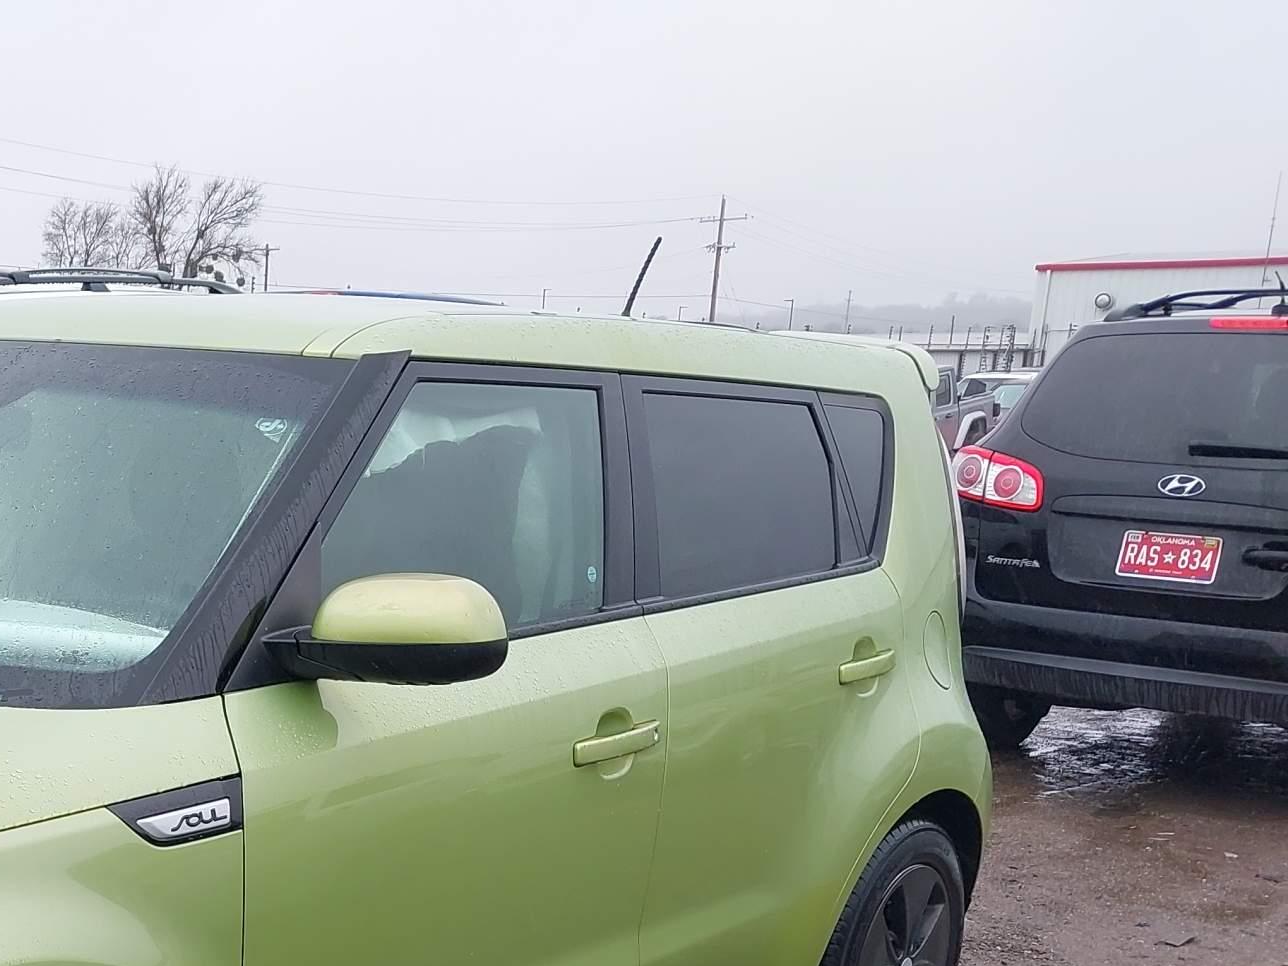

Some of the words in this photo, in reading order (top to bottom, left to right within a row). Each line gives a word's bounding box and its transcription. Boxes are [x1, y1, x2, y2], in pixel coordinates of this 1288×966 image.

[1151, 535, 1196, 546] OKLAHOMA
[1124, 543, 1161, 566] RAS
[1177, 548, 1214, 572] 834
[170, 808, 228, 833] SOUL
